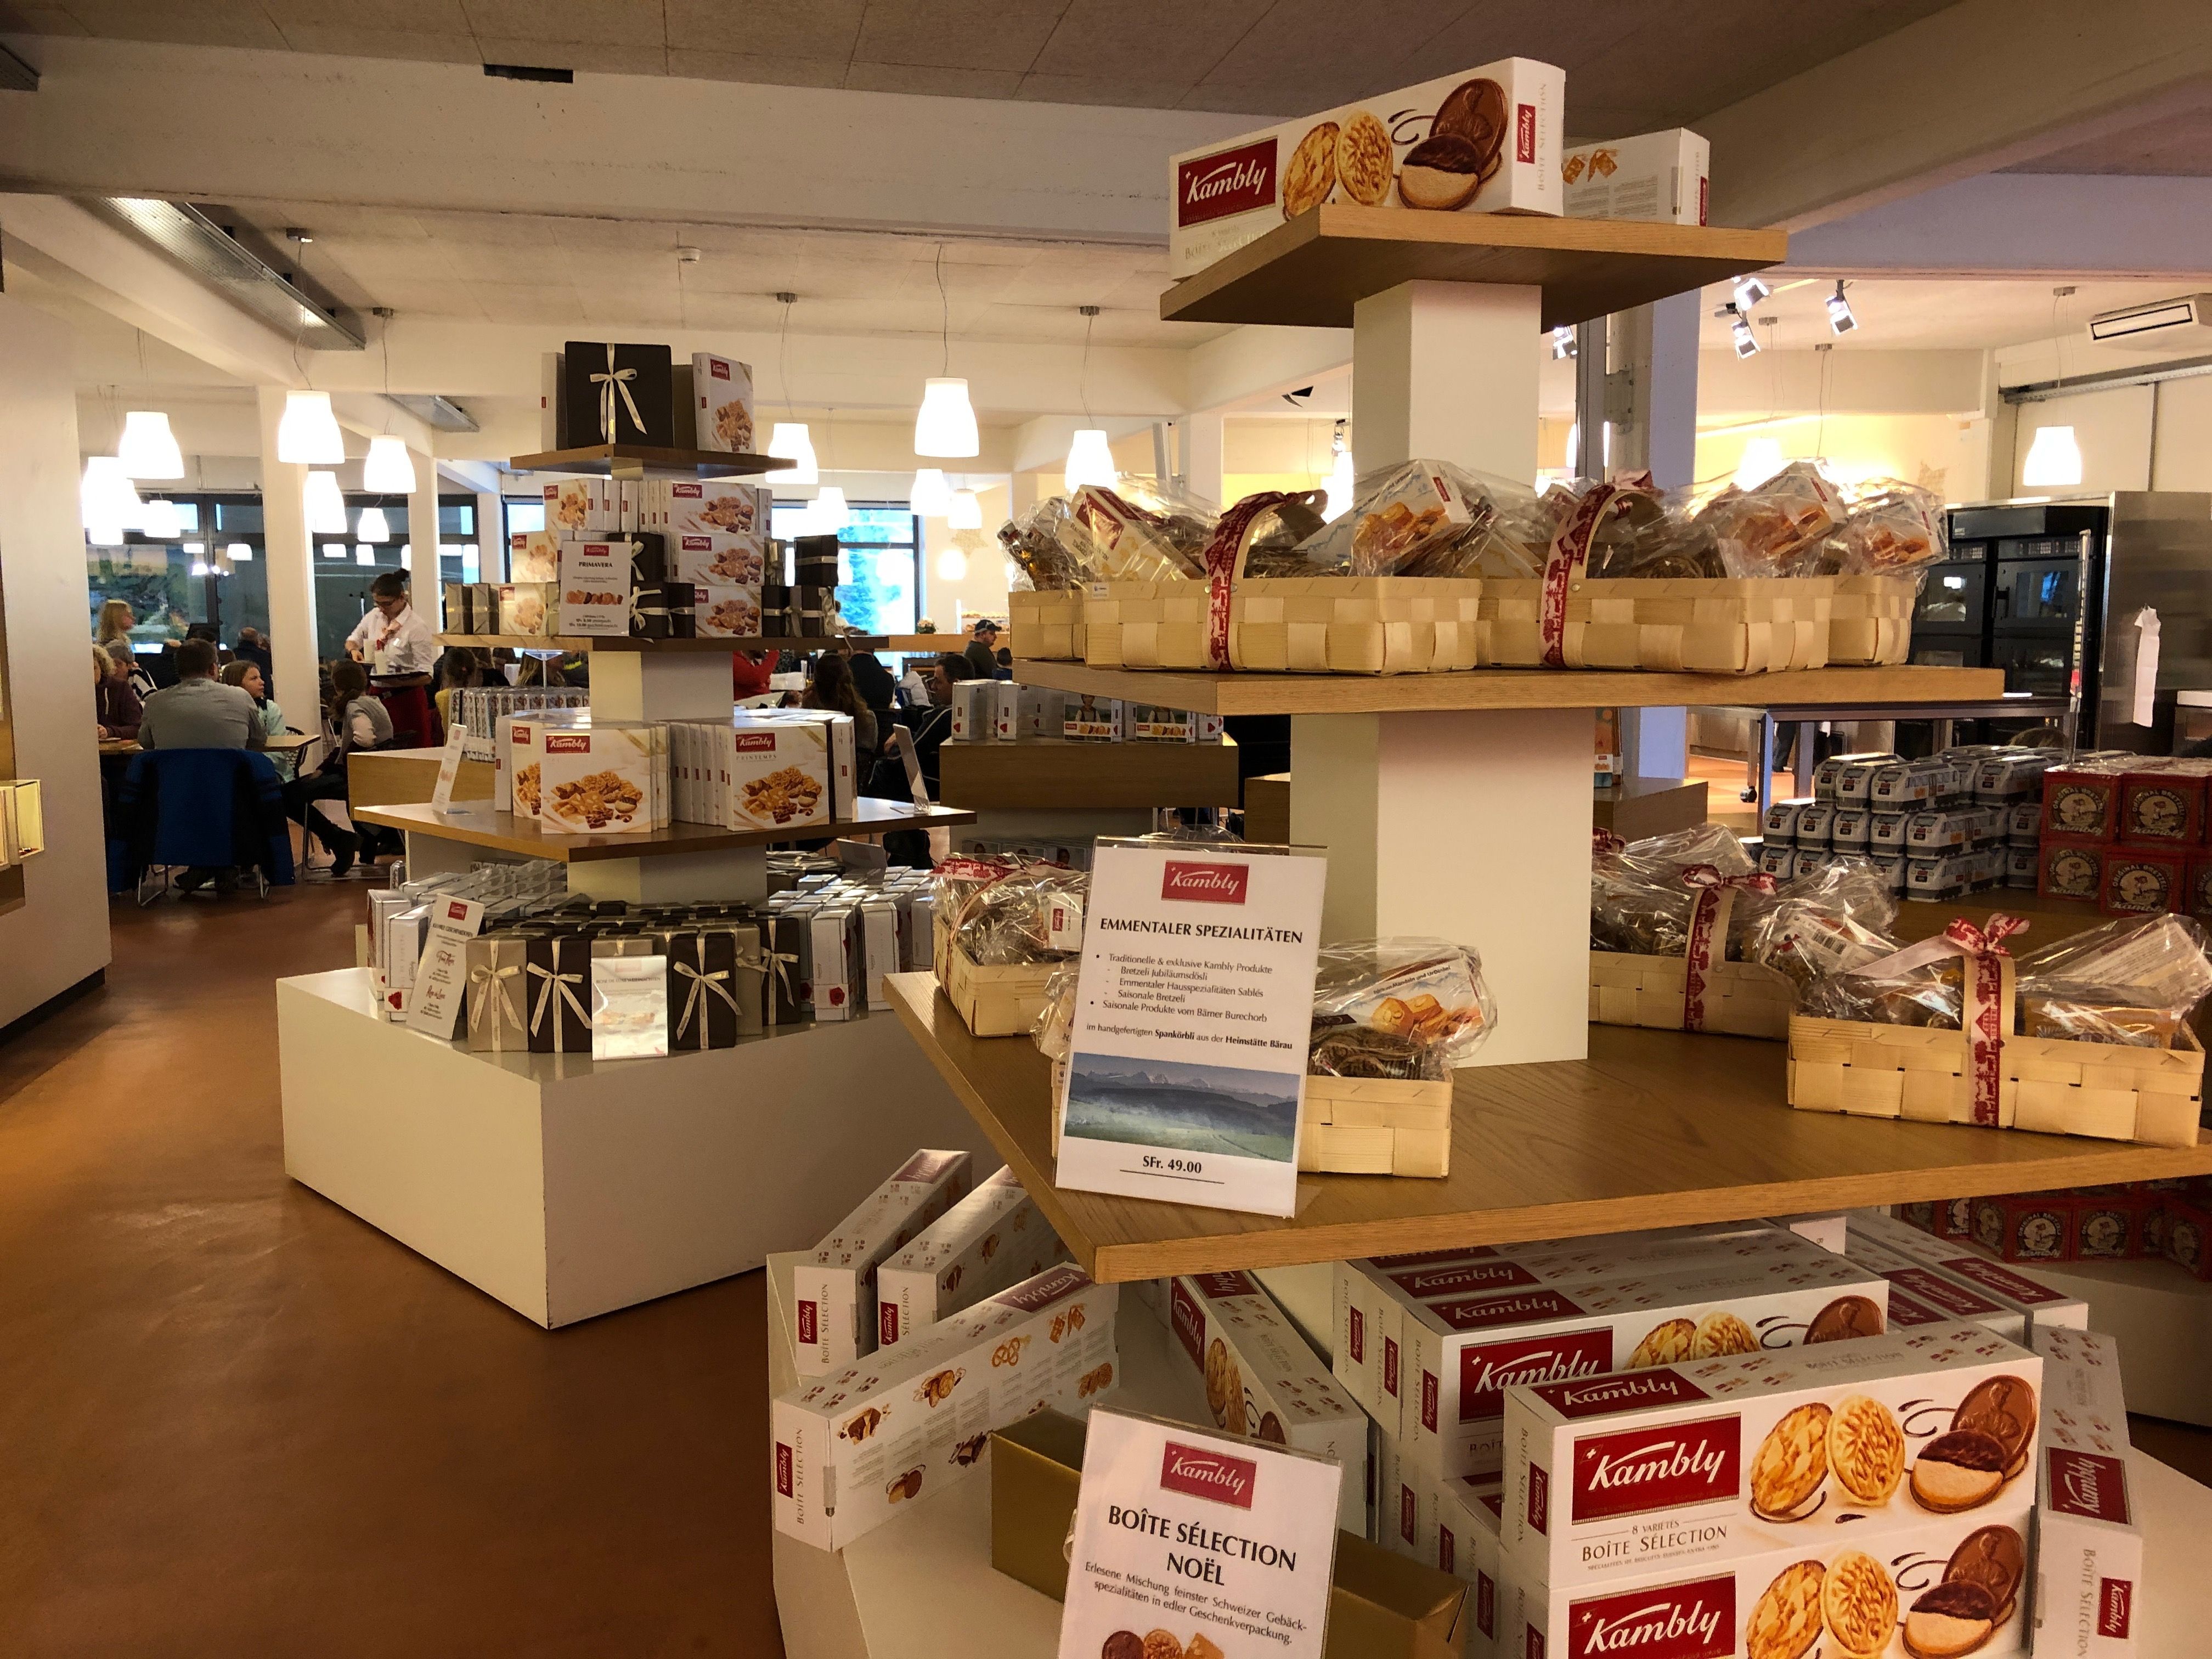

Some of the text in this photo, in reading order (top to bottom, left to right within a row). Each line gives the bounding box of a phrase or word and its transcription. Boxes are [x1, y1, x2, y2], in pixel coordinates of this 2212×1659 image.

[1521, 109, 1532, 159] Kambly
[1186, 159, 1267, 204] Kambly
[550, 738, 587, 751] Kambly
[740, 736, 772, 748] Kambly
[1170, 870, 1239, 895] Kambly
[2113, 865, 2167, 891] ORIGINAL BRETZELI
[1100, 918, 1303, 944] EMMENTALER SPEZIALITÄTEN
[1109, 953, 1156, 965] Traditionelle
[1166, 958, 1203, 968] exklusive
[1205, 961, 1234, 974] Kambly
[1237, 962, 1273, 974] Produkte
[1121, 966, 1207, 981] Bretzeli Jubiläumsdösli
[1118, 990, 1186, 1003] Saisonale Bretzeli
[1119, 978, 1263, 998] Emmentaler Hausspezialitäten Sablés
[1103, 1000, 1267, 1023] Saisonale Produkte vom Bärner Burechorb
[1086, 1023, 1293, 1049] im handgefertigten Spankörbli aus der Heimstätte Bärau
[1142, 1155, 1202, 1174] SFr. 49.00
[1414, 1267, 1514, 1288] Kambly
[803, 1304, 813, 1340] Kambly
[884, 1306, 894, 1342] Kambly
[1173, 1291, 1201, 1355] Kambly
[1455, 1297, 1559, 1319] Kambly
[1352, 1311, 1362, 1359] Kambly
[1386, 1343, 1396, 1390] Kambly
[1424, 1376, 1434, 1426] Kambly
[1564, 1378, 1679, 1406] Kambly
[1469, 1440, 1504, 1456] BOÎT
[1588, 1439, 1726, 1491] Kambly
[779, 1448, 789, 1492] Kambly
[1171, 1460, 1245, 1496] Kambly
[2064, 1457, 2106, 1514] Kambly
[1533, 1468, 1545, 1527] Kambly
[1108, 1505, 1296, 1572] BOÎTE SÉLECTION
[1582, 1525, 1728, 1561] BOÎTE SÉLECTION
[1632, 1520, 1679, 1535] 8 VARIÉTÉS
[1166, 1553, 1225, 1585] NOËL
[1085, 1561, 1307, 1631] Erlesene Mischung feinster Schweizer Gebäck-
[1093, 1580, 1293, 1644] spezialitäten in edler Geschenkverpackung.
[2104, 1583, 2125, 1633] Kambly
[1583, 1600, 1722, 1655] Kambly
